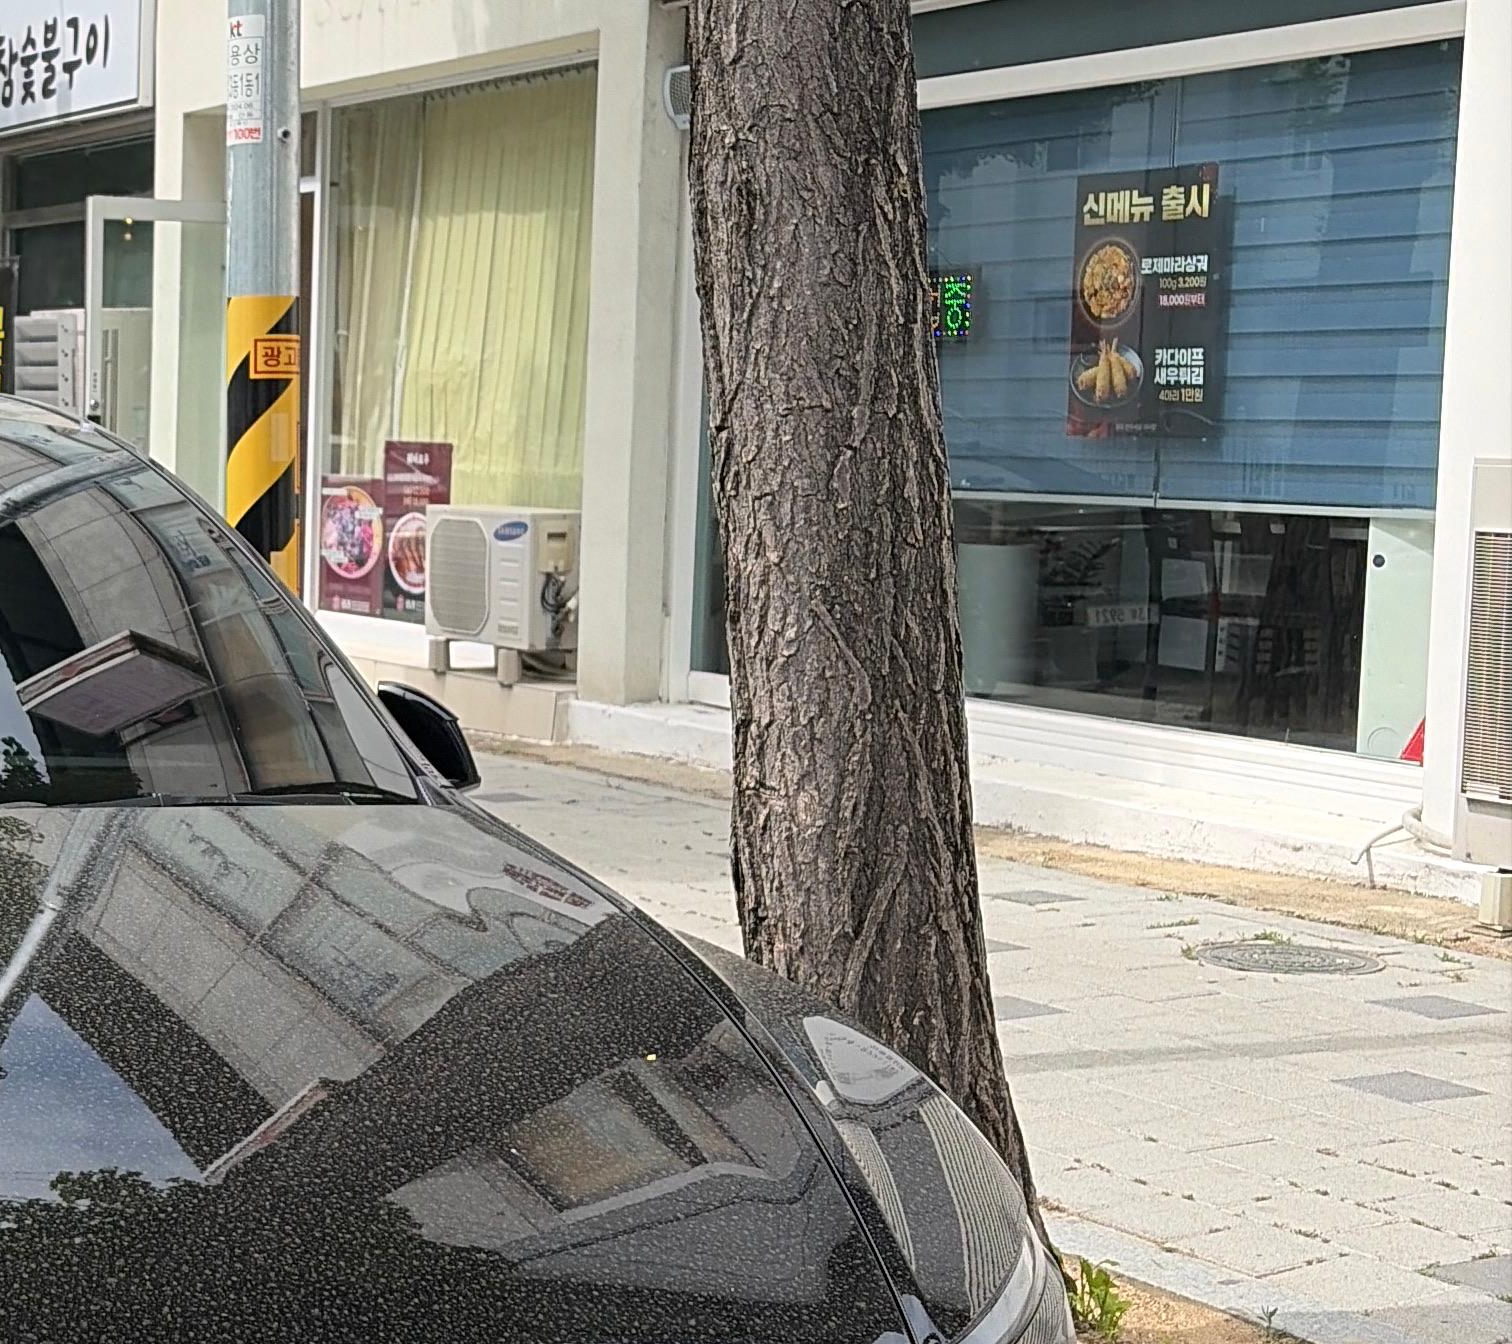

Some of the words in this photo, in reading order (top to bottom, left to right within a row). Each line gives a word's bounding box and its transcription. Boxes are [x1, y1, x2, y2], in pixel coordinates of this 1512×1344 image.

[1083, 189, 1155, 226] 신메뉴
[1162, 183, 1211, 221] 출시
[1154, 347, 1205, 366] 카다이프
[1154, 367, 1204, 385] 새우튀김
